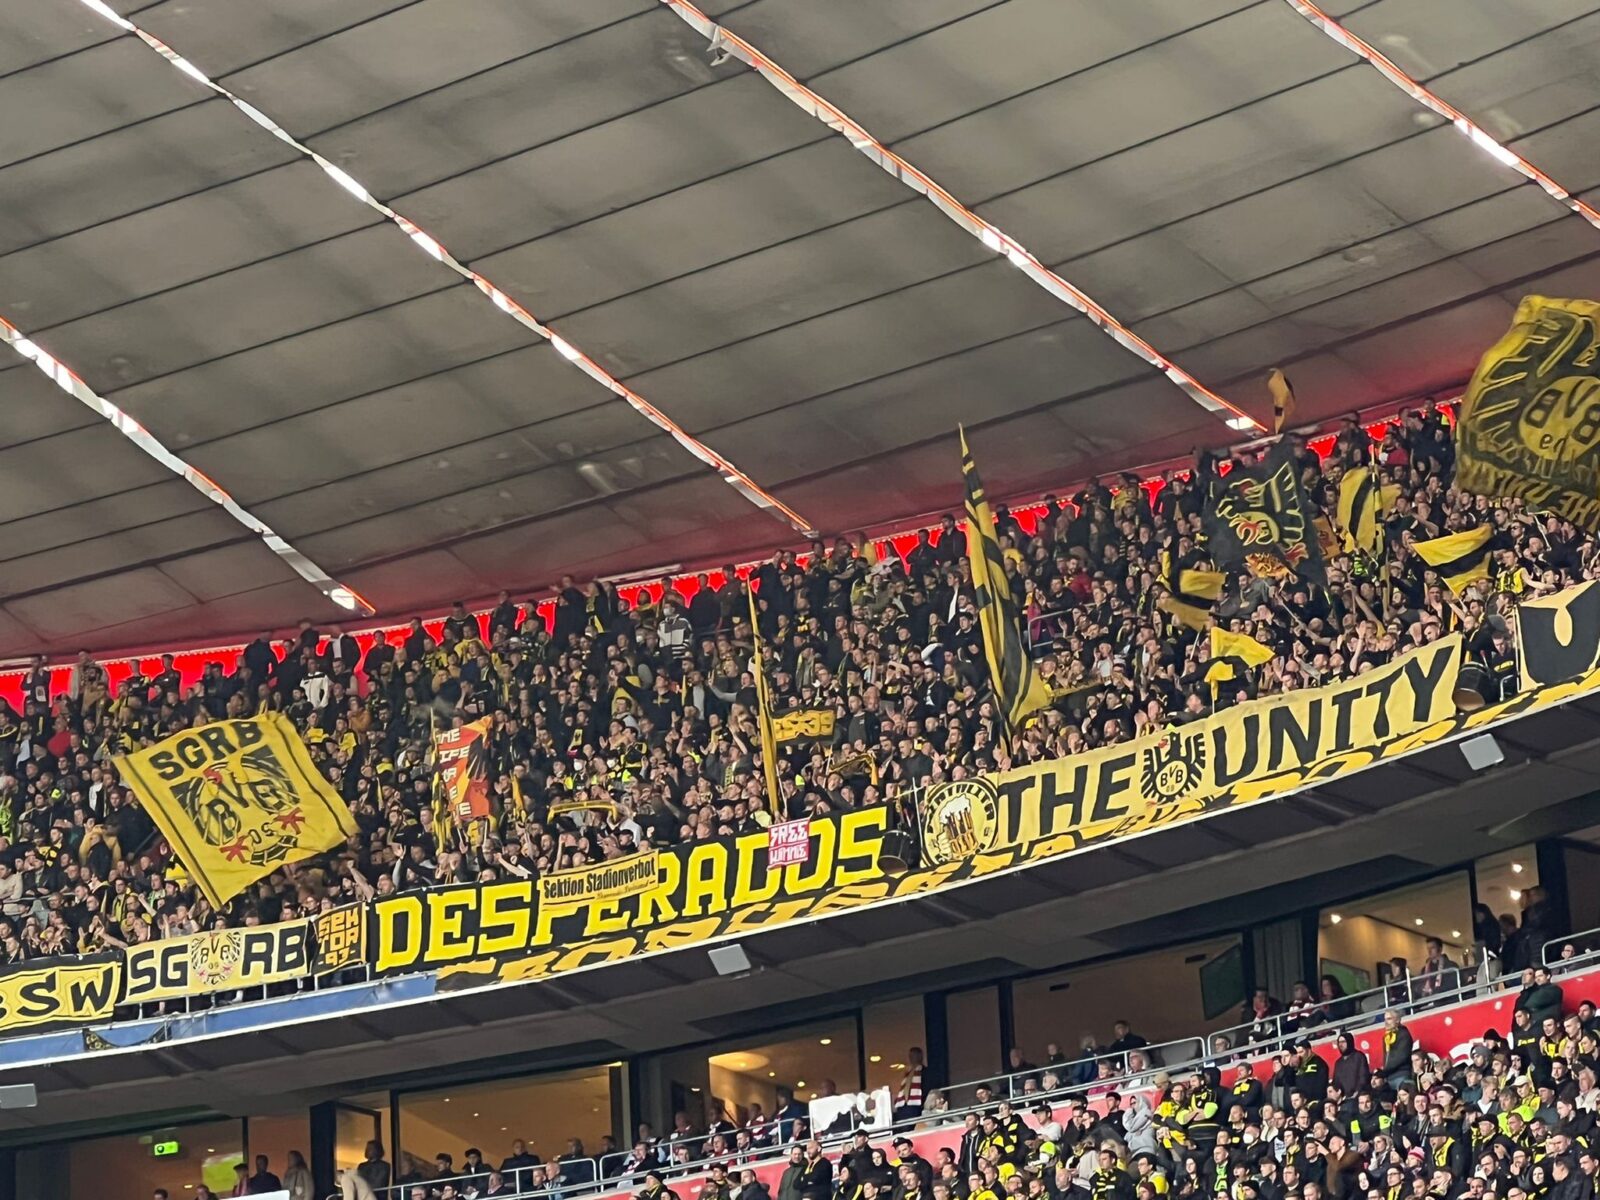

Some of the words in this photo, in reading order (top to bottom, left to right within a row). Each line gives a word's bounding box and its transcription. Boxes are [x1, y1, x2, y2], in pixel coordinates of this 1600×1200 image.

[148, 721, 264, 781] SGRB
[998, 752, 1136, 844] THE
[1211, 645, 1456, 787] UNITY
[1160, 764, 1184, 788] BVB
[543, 876, 585, 899] Sektion
[586, 857, 656, 893] Stadionverbot
[129, 944, 189, 996] SG
[242, 925, 307, 976] RB
[0, 966, 114, 1018] SW
